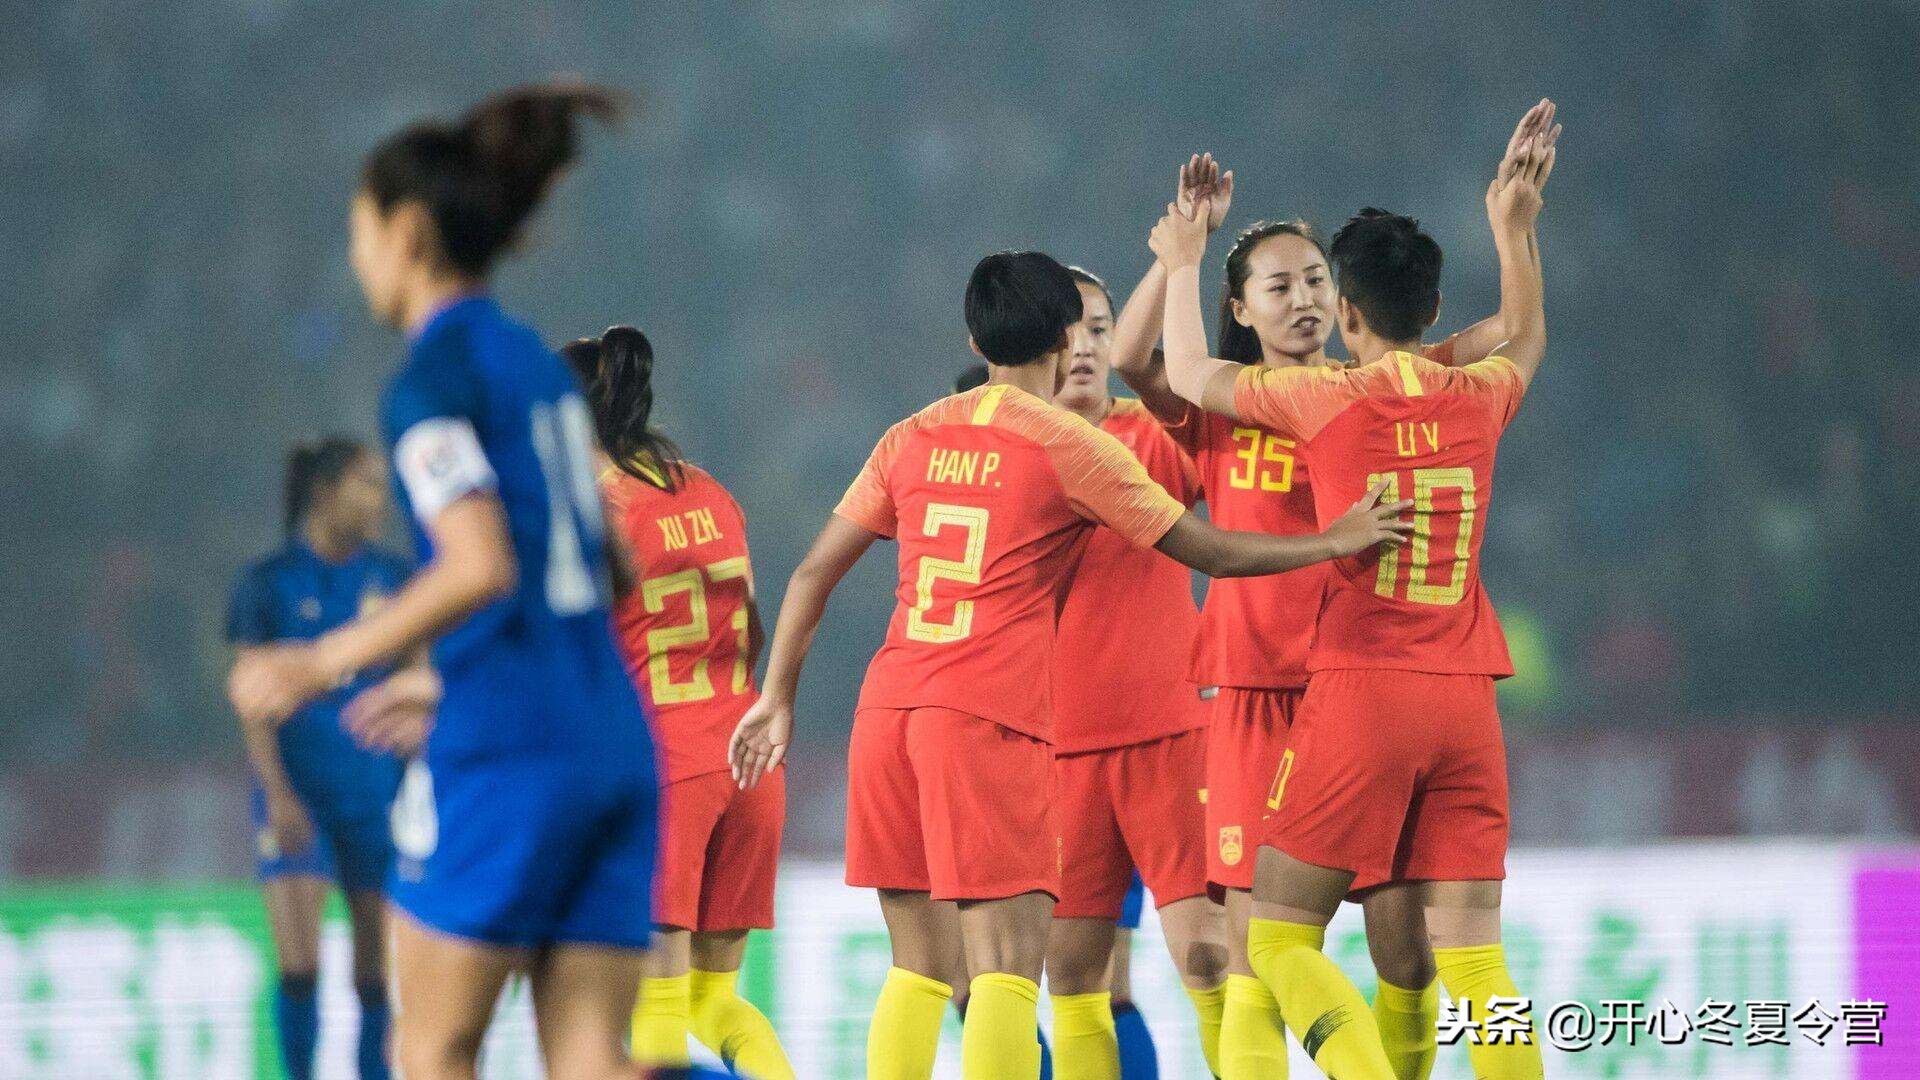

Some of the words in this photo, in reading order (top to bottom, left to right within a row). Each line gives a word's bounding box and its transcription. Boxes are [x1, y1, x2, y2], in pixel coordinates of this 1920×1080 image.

[926, 447, 979, 485] HAN
[980, 452, 1001, 488] P.
[1229, 426, 1297, 492] 35
[1394, 421, 1417, 457] LI
[656, 514, 689, 552] XU
[684, 506, 724, 546] ZH.
[1366, 466, 1477, 606] 10
[905, 502, 990, 644] 2
[642, 555, 749, 706] 27
